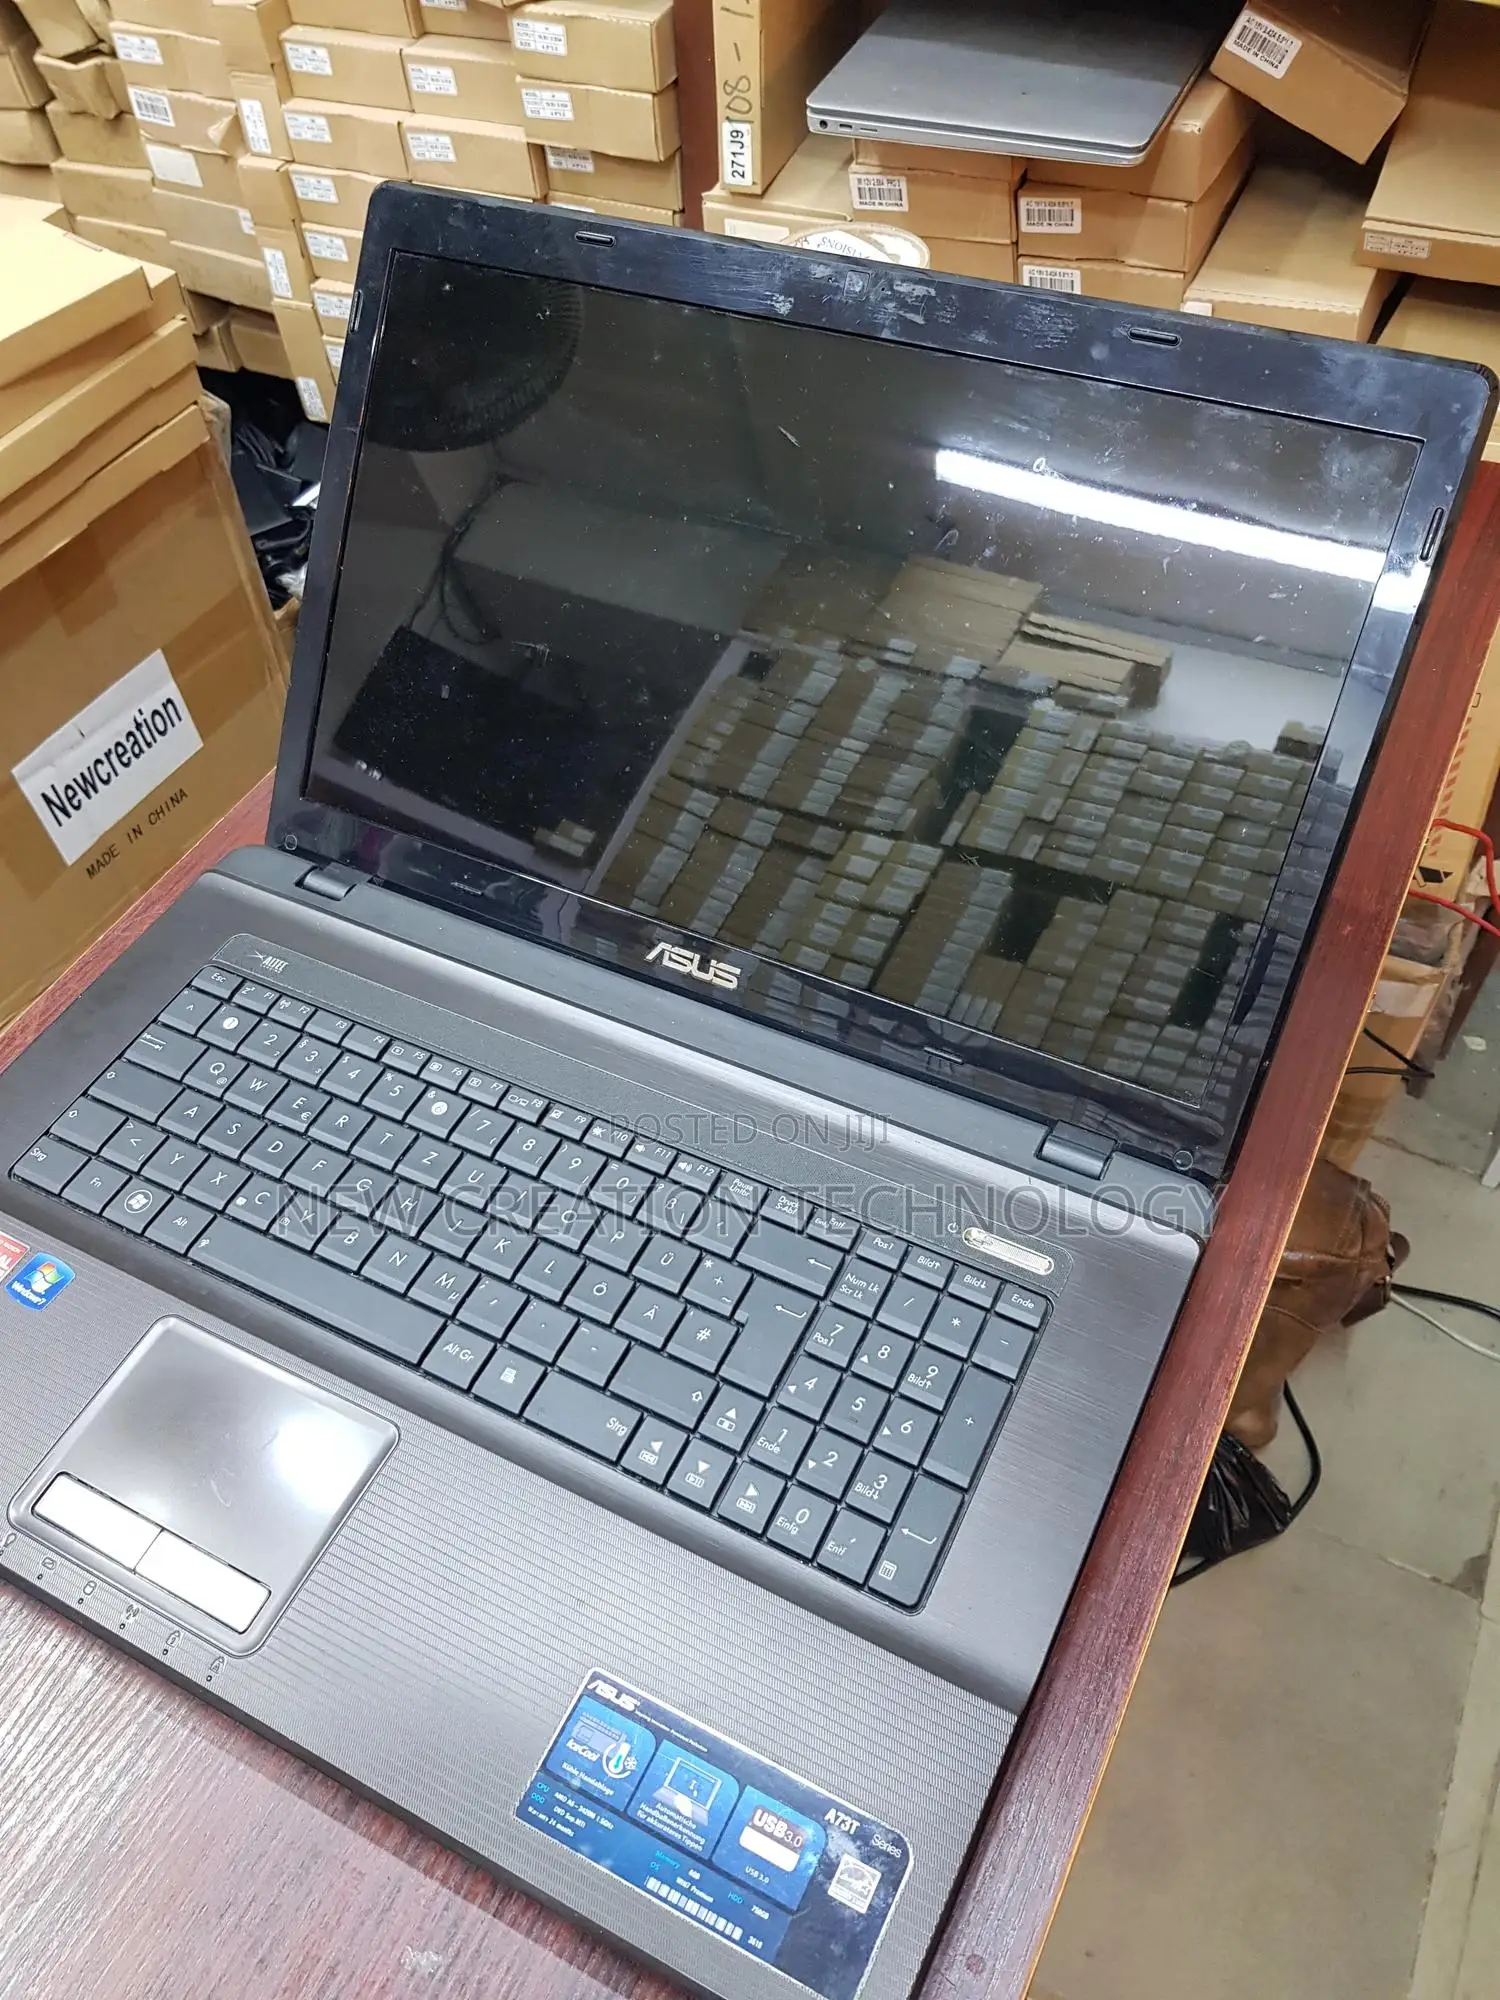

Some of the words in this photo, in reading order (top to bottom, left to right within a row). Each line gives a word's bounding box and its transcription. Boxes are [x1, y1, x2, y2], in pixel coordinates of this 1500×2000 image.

[1233, 39, 1251, 53] MADE
[1260, 55, 1279, 70] CHINA
[730, 129, 746, 180] 271J9
[41, 697, 183, 828] Newcreation
[85, 843, 120, 879] MADE
[127, 824, 144, 844] IN
[148, 788, 188, 825] CHINA
[643, 941, 742, 990] ASUS
[211, 973, 226, 983] Esc
[263, 991, 276, 1000] F1
[298, 1004, 312, 1014] F2
[335, 1021, 348, 1029] F3
[263, 1034, 278, 1046] 2
[373, 1035, 386, 1044] F4
[304, 1051, 319, 1063] 3
[412, 1050, 425, 1060] F5
[209, 1062, 225, 1076] Q
[347, 1068, 361, 1081] 4
[451, 1066, 464, 1076] F6
[249, 1078, 269, 1092] W
[389, 1085, 404, 1097] 5
[490, 1082, 504, 1091] F7
[292, 1096, 307, 1109] E
[531, 1098, 544, 1108] F8
[183, 1105, 199, 1118] A
[335, 1114, 350, 1128] R
[476, 1120, 492, 1131] 7
[574, 1115, 587, 1124] F9
[227, 1123, 242, 1135] S
[610, 1129, 628, 1141] F10
[379, 1132, 394, 1145] T
[522, 1139, 537, 1152] 8
[268, 1140, 284, 1153] D
[654, 1147, 672, 1159] F11
[30, 1147, 47, 1161] Strg
[169, 1152, 185, 1165] Y
[422, 1151, 440, 1165] Z
[311, 1159, 328, 1171] F
[568, 1157, 582, 1171] 9
[696, 1164, 715, 1177] F12
[90, 1177, 102, 1188] Fn
[210, 1171, 228, 1186] X
[468, 1169, 485, 1183] U
[356, 1178, 373, 1192] G
[732, 1178, 754, 1192] Pause
[254, 1191, 271, 1205] C
[400, 1197, 418, 1212] H
[778, 1195, 801, 1209] Druck
[172, 1216, 188, 1227] Alt
[299, 1209, 315, 1224] V
[448, 1219, 464, 1232] J
[343, 1230, 360, 1244] B
[609, 1231, 625, 1244] P
[872, 1237, 894, 1251] Pos1
[493, 1238, 512, 1254] K
[388, 1250, 408, 1267] N
[661, 1252, 675, 1266] Ü
[543, 1260, 556, 1274] L
[434, 1271, 457, 1290] M
[844, 1272, 867, 1288] Num
[867, 1282, 880, 1293] Lk
[593, 1281, 608, 1296] Ö
[839, 1284, 854, 1294] Scr
[1011, 1293, 1035, 1310] Ende
[643, 1304, 660, 1320] Ä
[696, 1326, 712, 1341] #
[831, 1323, 845, 1338] 7
[813, 1332, 834, 1348] Pos1
[442, 1342, 459, 1355] Alt
[459, 1348, 476, 1362] Gr
[877, 1344, 891, 1360] 8
[926, 1365, 939, 1379] 9
[803, 1375, 819, 1392] 4
[851, 1396, 866, 1412] 5
[605, 1416, 628, 1437] Strg
[900, 1420, 913, 1434] 6
[778, 1428, 789, 1443] 1
[756, 1436, 781, 1454] Ende
[823, 1451, 839, 1467] 2
[874, 1474, 888, 1491] 3
[776, 1516, 800, 1535] Einfg
[826, 1541, 847, 1556] Entf
[586, 1679, 641, 1712] ASUS
[536, 1782, 550, 1793] CPU
[531, 1792, 545, 1804] ODD
[823, 1807, 861, 1835] A73T
[871, 1834, 902, 1859] Series
[745, 1865, 759, 1879] USB
[757, 1873, 770, 1885] 3.0
[727, 1891, 744, 1904] HDD
